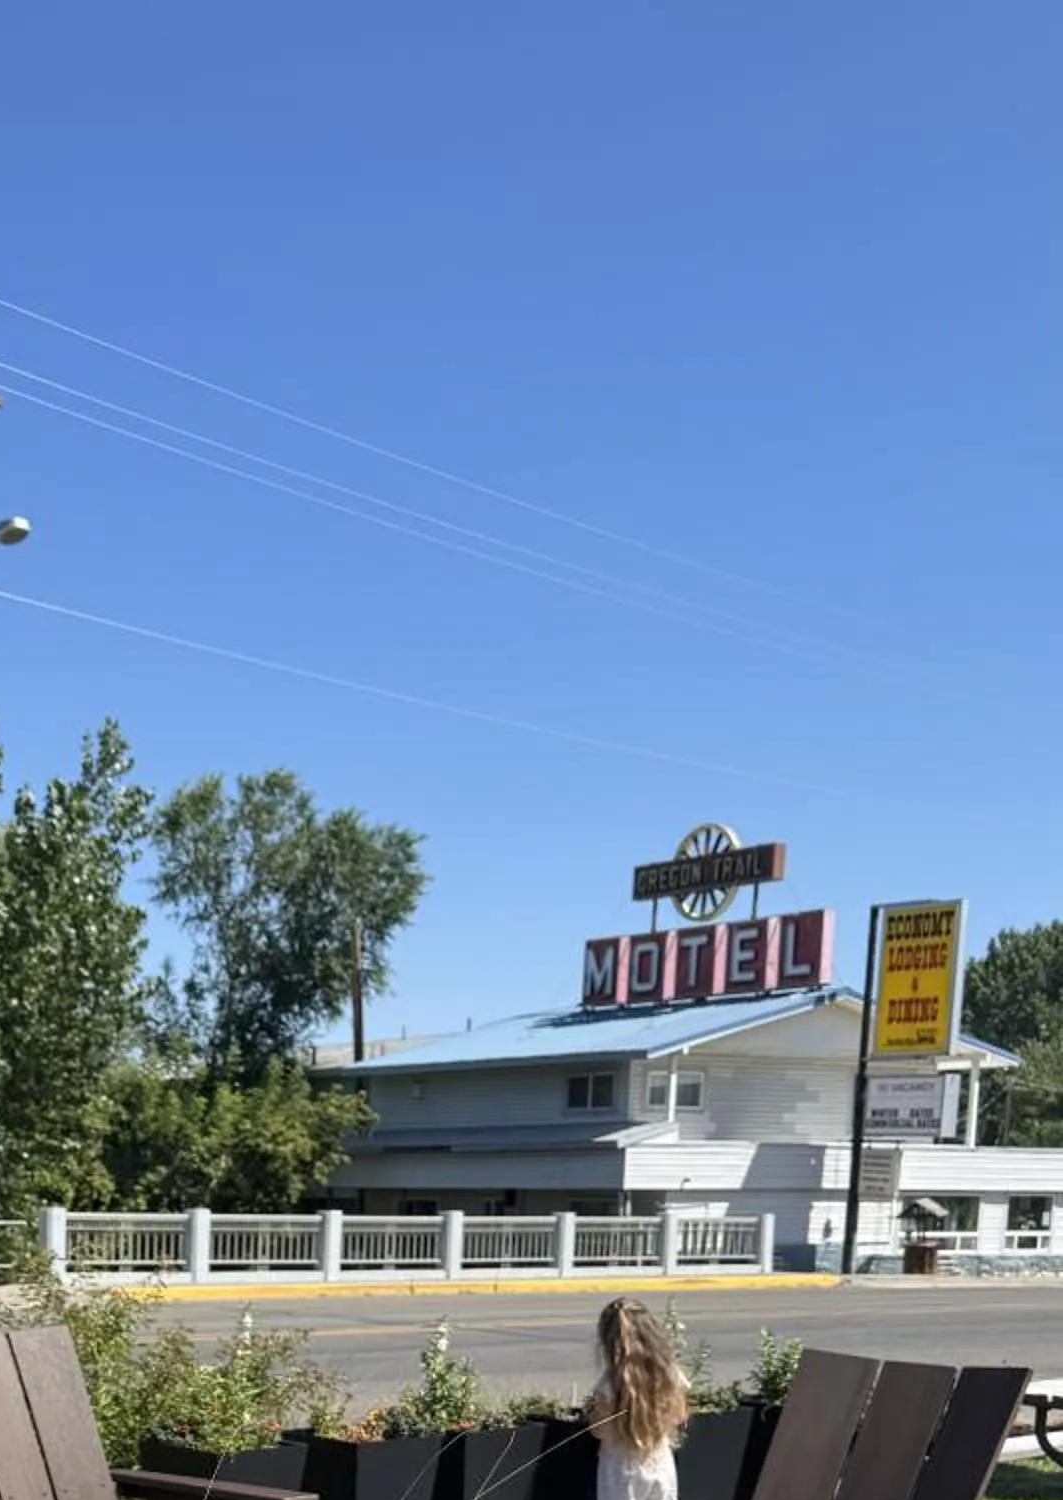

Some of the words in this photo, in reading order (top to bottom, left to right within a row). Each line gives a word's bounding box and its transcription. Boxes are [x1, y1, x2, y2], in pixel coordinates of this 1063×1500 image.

[638, 863, 703, 894] OREGON
[713, 851, 762, 882] TRAIL
[886, 910, 954, 940] ECONOMY
[585, 922, 811, 996] MOTEL
[887, 943, 948, 972] LODGING
[887, 996, 939, 1024] DINING
